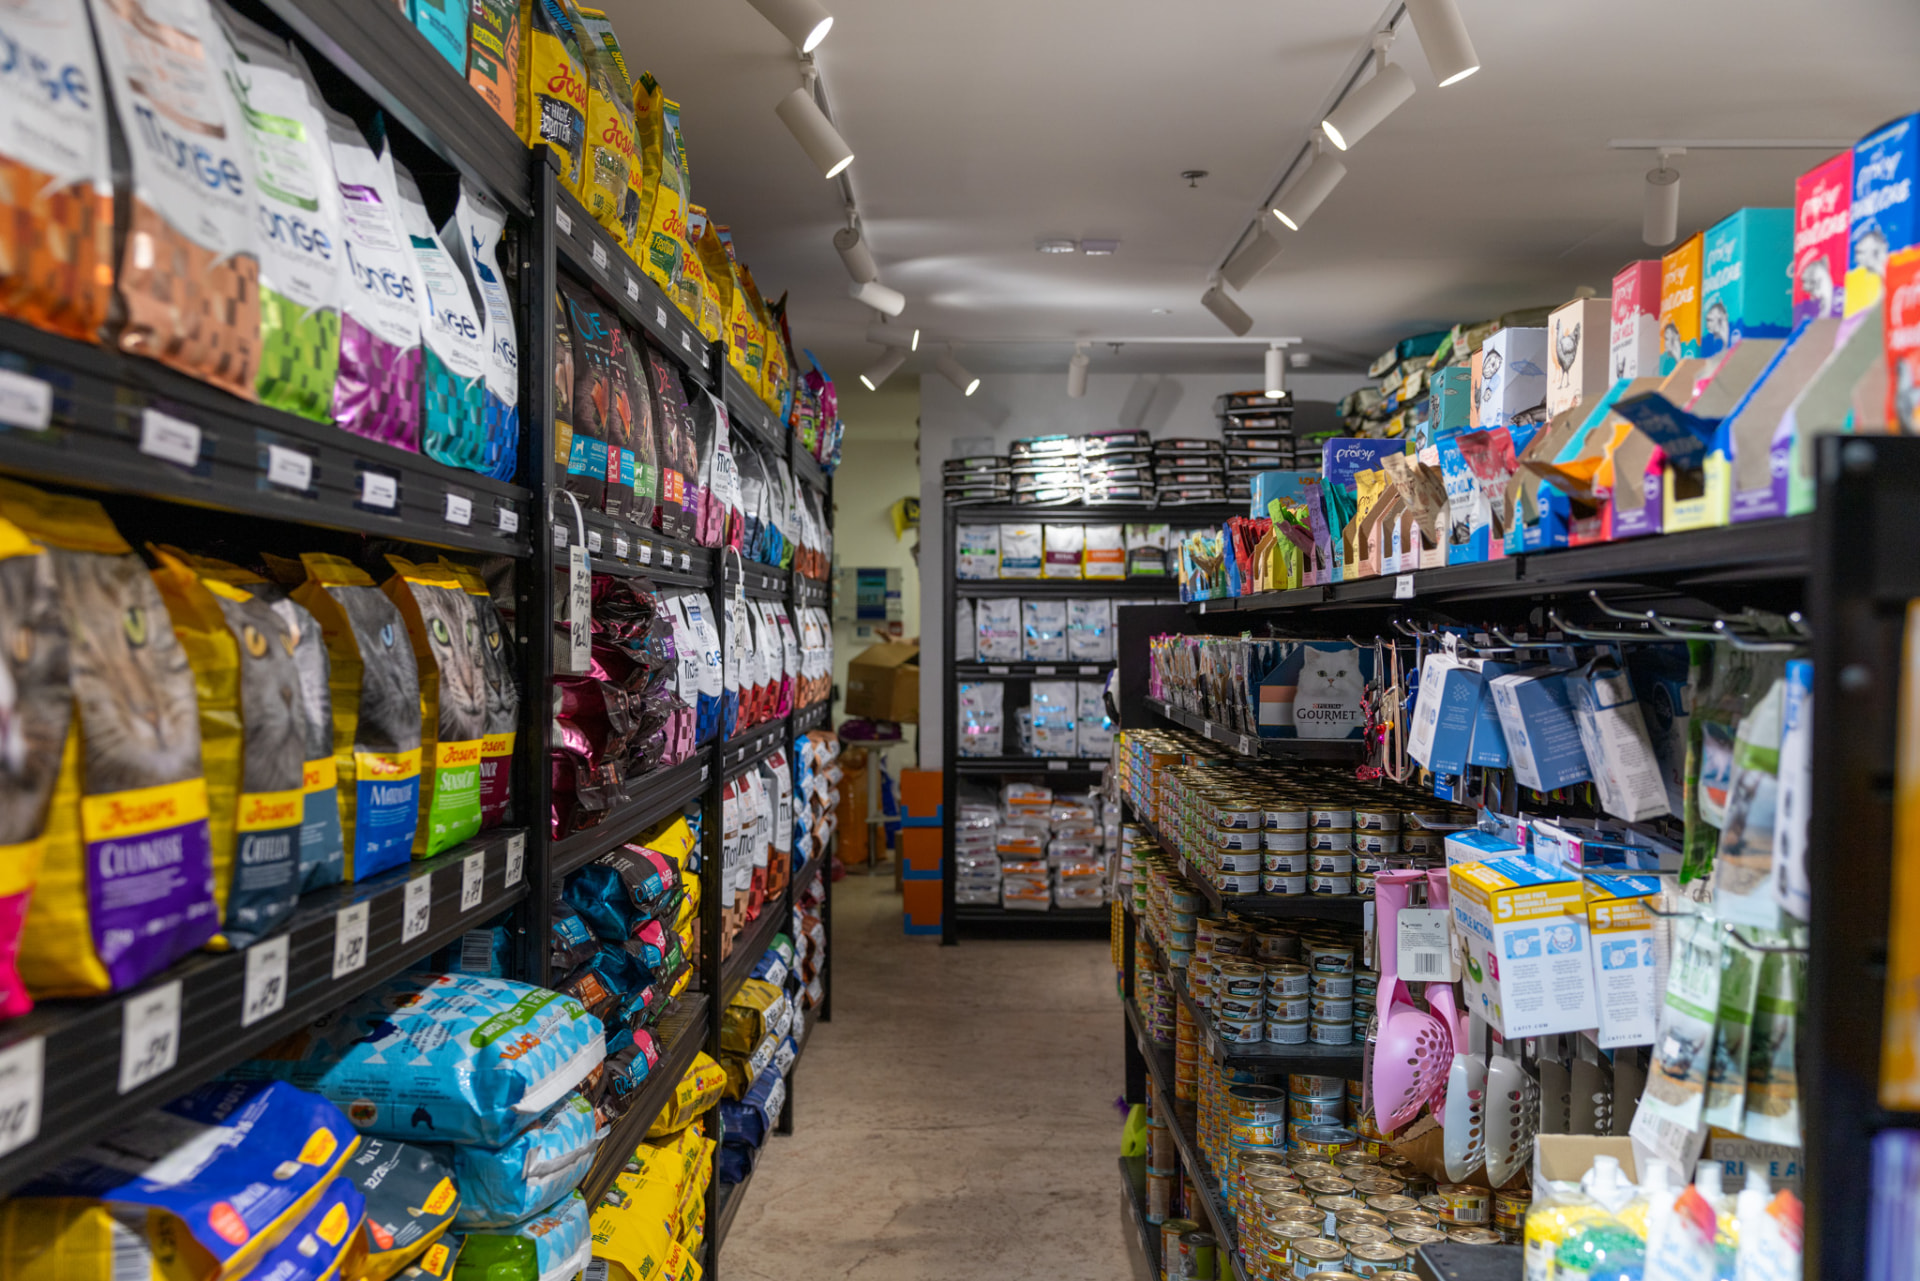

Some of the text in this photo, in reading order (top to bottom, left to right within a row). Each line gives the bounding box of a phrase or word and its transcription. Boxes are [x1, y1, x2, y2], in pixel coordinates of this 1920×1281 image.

[1296, 708, 1357, 721] GOURMET
[1497, 896, 1514, 919] 5
[1514, 893, 1532, 901] VALUE
[1455, 907, 1474, 931] TRIPLE
[1473, 918, 1494, 942] ACTION
[1596, 908, 1611, 929] 5
